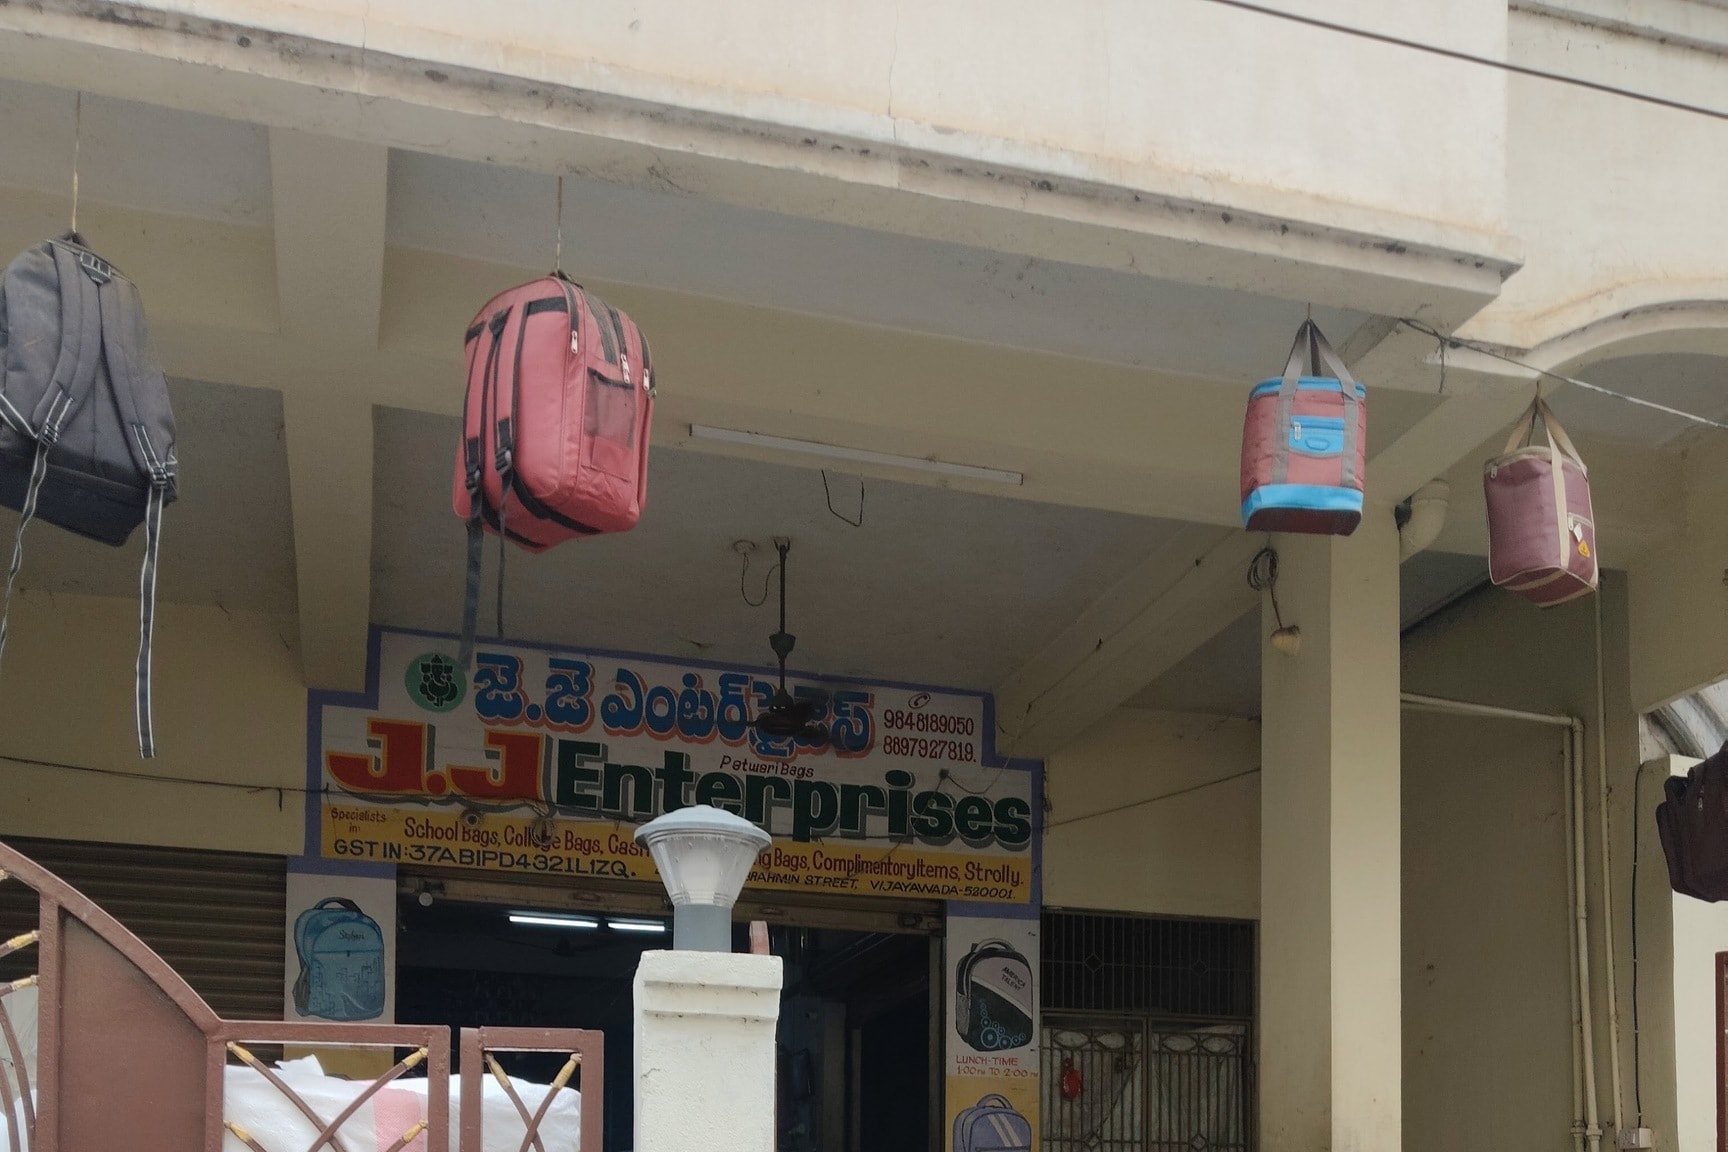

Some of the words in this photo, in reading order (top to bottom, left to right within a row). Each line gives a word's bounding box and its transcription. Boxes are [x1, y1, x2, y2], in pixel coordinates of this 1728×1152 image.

[780, 762, 815, 778] Bags
[556, 738, 1031, 844] Enterprises
[331, 807, 387, 823] Specialists
[404, 816, 459, 841] School
